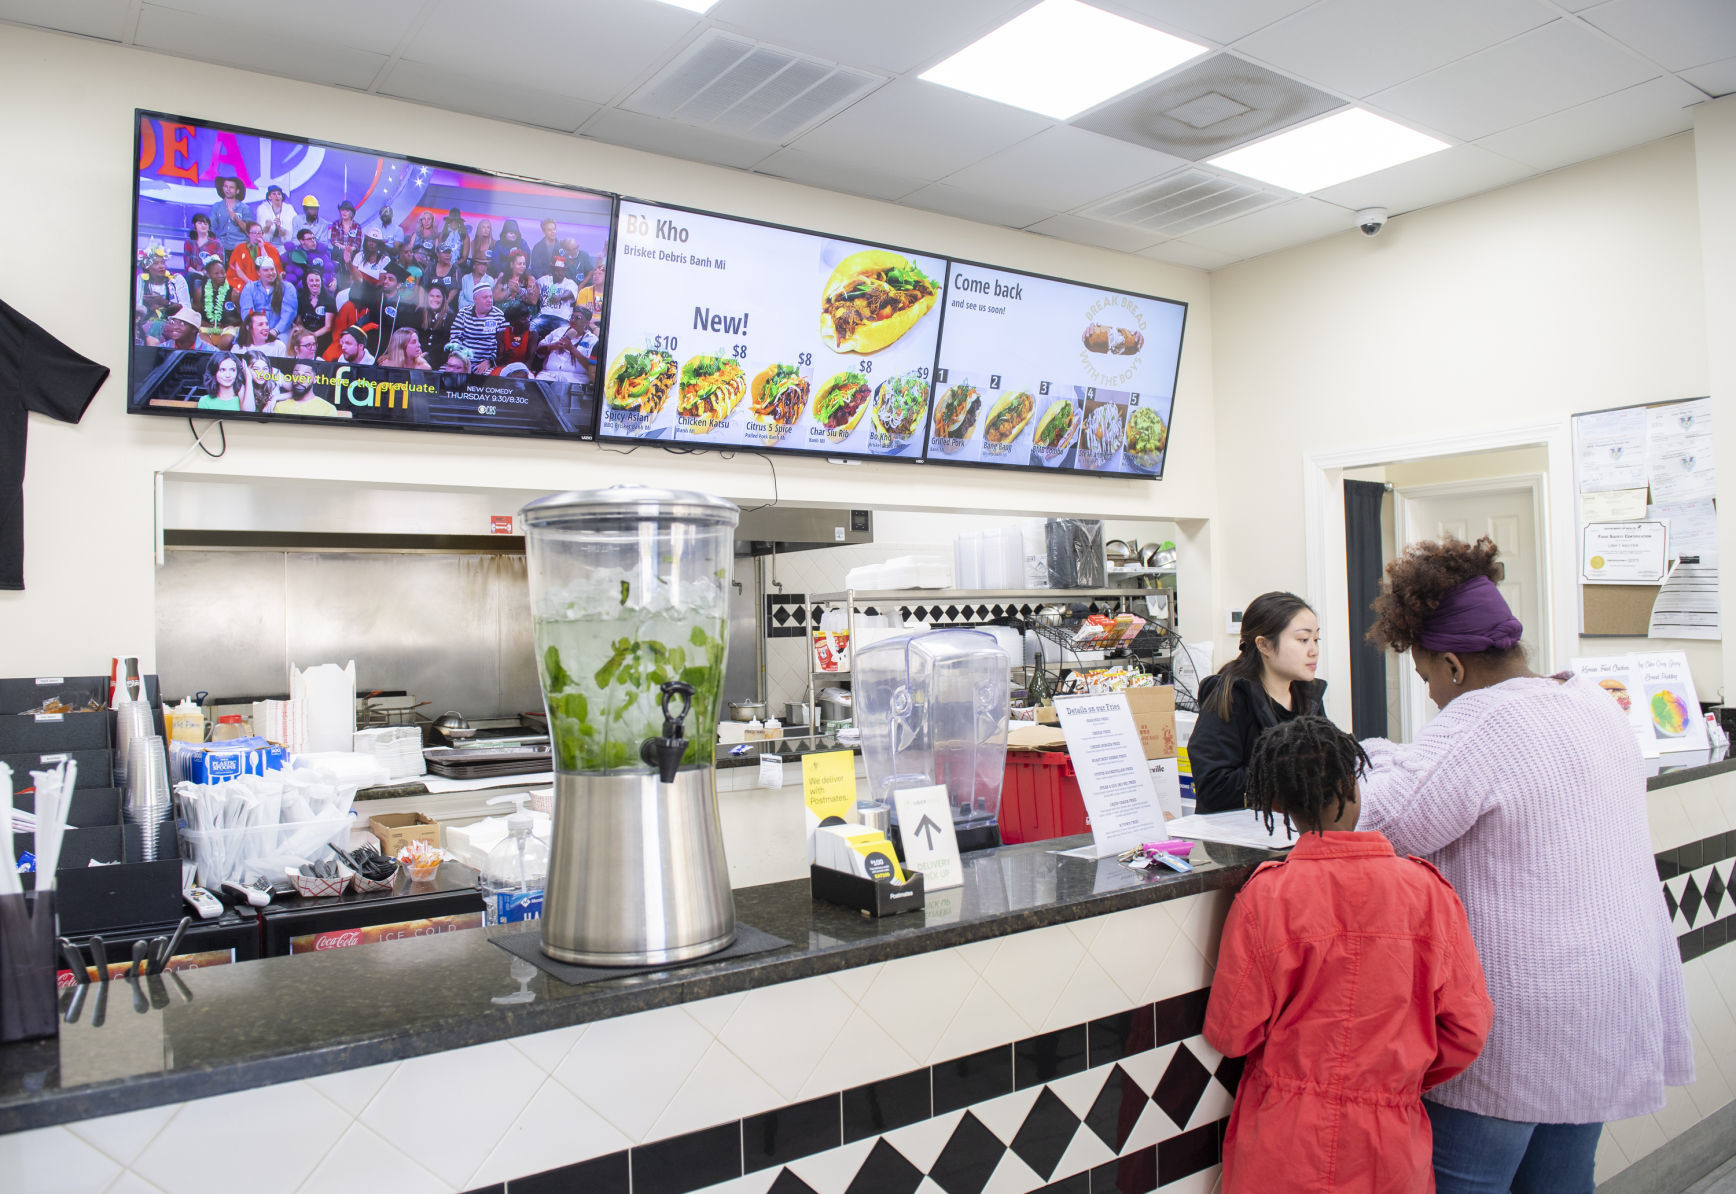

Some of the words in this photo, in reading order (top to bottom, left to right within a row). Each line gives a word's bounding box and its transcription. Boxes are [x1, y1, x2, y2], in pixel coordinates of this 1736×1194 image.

[626, 214, 649, 236] Bò
[656, 219, 689, 243] Kho
[624, 244, 656, 259] Brisket
[659, 250, 687, 264] Debris
[690, 255, 712, 268] Banh
[714, 259, 726, 270] Mi
[954, 273, 990, 295] Come
[994, 279, 1023, 301] back
[951, 299, 965, 308] and
[966, 302, 977, 311] see
[978, 304, 986, 312] us
[988, 306, 1006, 315] soon!
[1085, 295, 1119, 321] BREAK
[1120, 296, 1147, 330] BREAD
[693, 306, 749, 336] New!
[654, 334, 678, 351] $10
[732, 344, 747, 360] $8
[798, 351, 812, 367] $8
[859, 360, 872, 375] $8
[916, 366, 929, 380] $9
[1080, 350, 1100, 381] WITH
[1101, 374, 1118, 386] THE
[1119, 357, 1142, 384] BOYS
[255, 369, 279, 382] You
[284, 373, 312, 384] over
[316, 374, 352, 387] there,
[357, 377, 378, 389] the
[381, 380, 438, 394] graduate.
[938, 369, 945, 381] 1
[334, 366, 409, 409] fam
[992, 376, 998, 388] 2
[1041, 383, 1048, 394] 3
[446, 391, 490, 401] THURSDAY
[486, 387, 513, 395] COMEDY
[1087, 388, 1094, 399] 4
[1131, 394, 1137, 404] 5
[486, 406, 496, 415] CBS
[605, 410, 625, 423] Spicy
[628, 411, 649, 422] Asian
[678, 416, 707, 427] Chicken
[709, 418, 730, 429] Katsu
[746, 421, 767, 432] Citrus
[768, 423, 773, 432] 5
[774, 423, 793, 435] Spice
[810, 427, 825, 437] Char
[826, 428, 837, 437] Siu
[838, 428, 850, 438] Rib
[931, 437, 950, 446] Grilled
[951, 438, 965, 448] Pork
[1066, 705, 1088, 715] Details
[1106, 703, 1121, 712] Fries
[808, 777, 820, 785] We
[822, 775, 844, 784] deliver
[810, 787, 825, 795] with
[811, 795, 849, 805] Postmates.
[917, 858, 951, 871] DELIVERY
[315, 931, 360, 950] Coca-Cola
[379, 932, 405, 943] ICE
